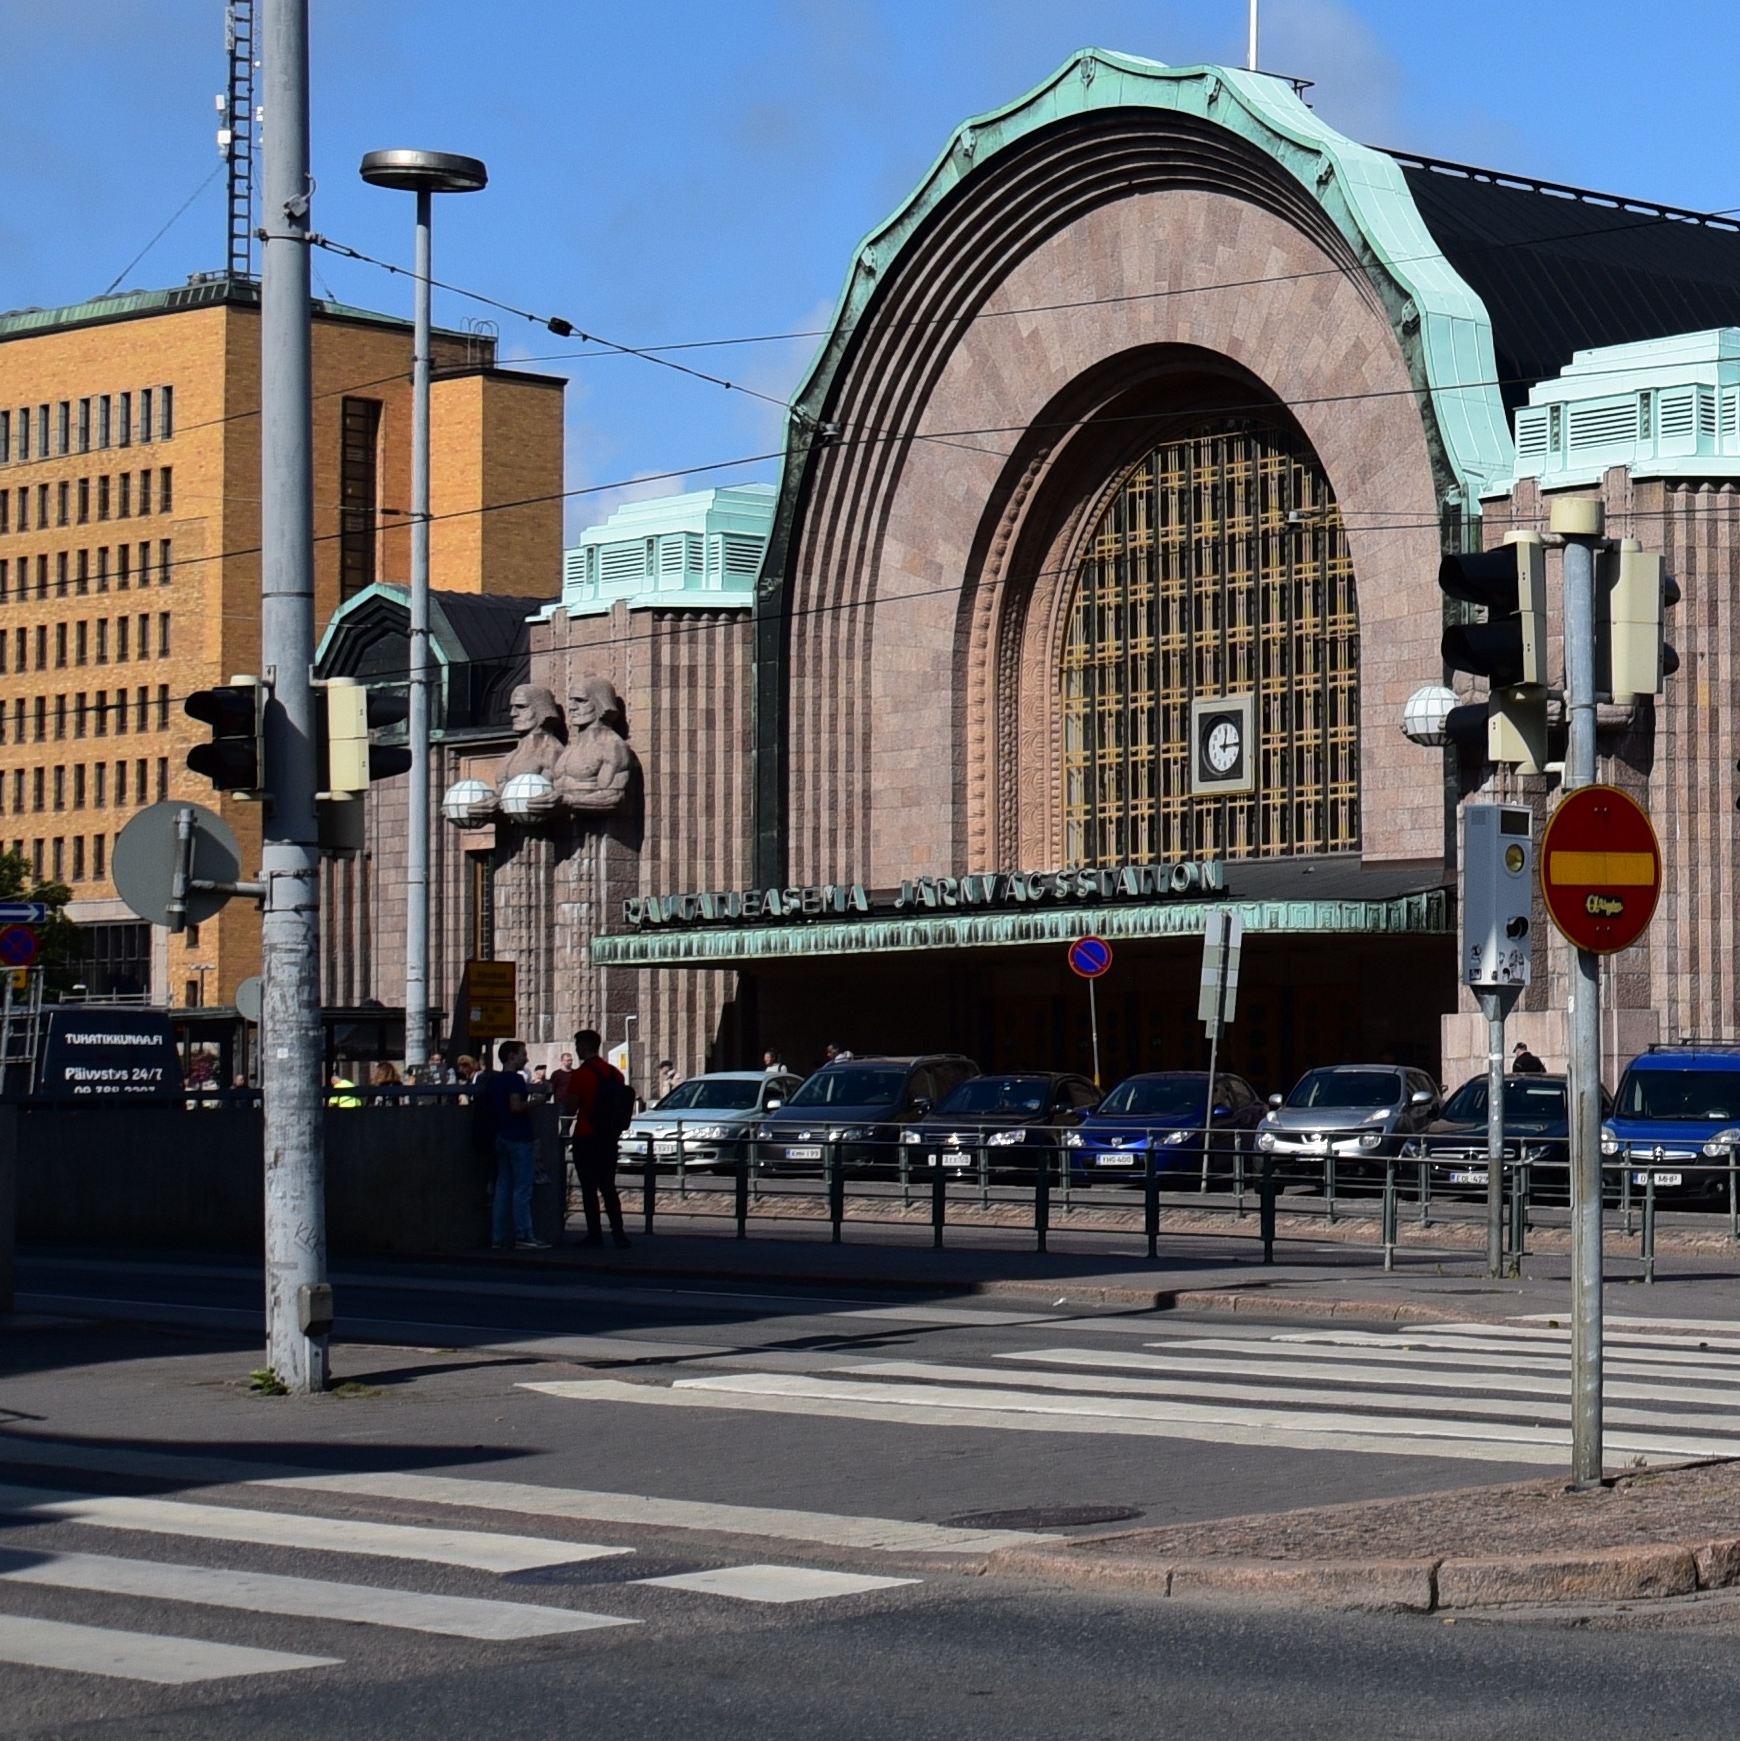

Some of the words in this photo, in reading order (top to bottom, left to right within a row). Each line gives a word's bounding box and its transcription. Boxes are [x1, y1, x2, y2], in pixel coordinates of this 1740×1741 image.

[622, 884, 869, 924] RAUTATIEASEMA
[894, 860, 1224, 909] JÄRNVÄGSSTATION
[65, 1033, 163, 1046] TUHATIKKUNAA.FI
[65, 1067, 129, 1081] Päivystys
[132, 1068, 163, 1081] 24/7
